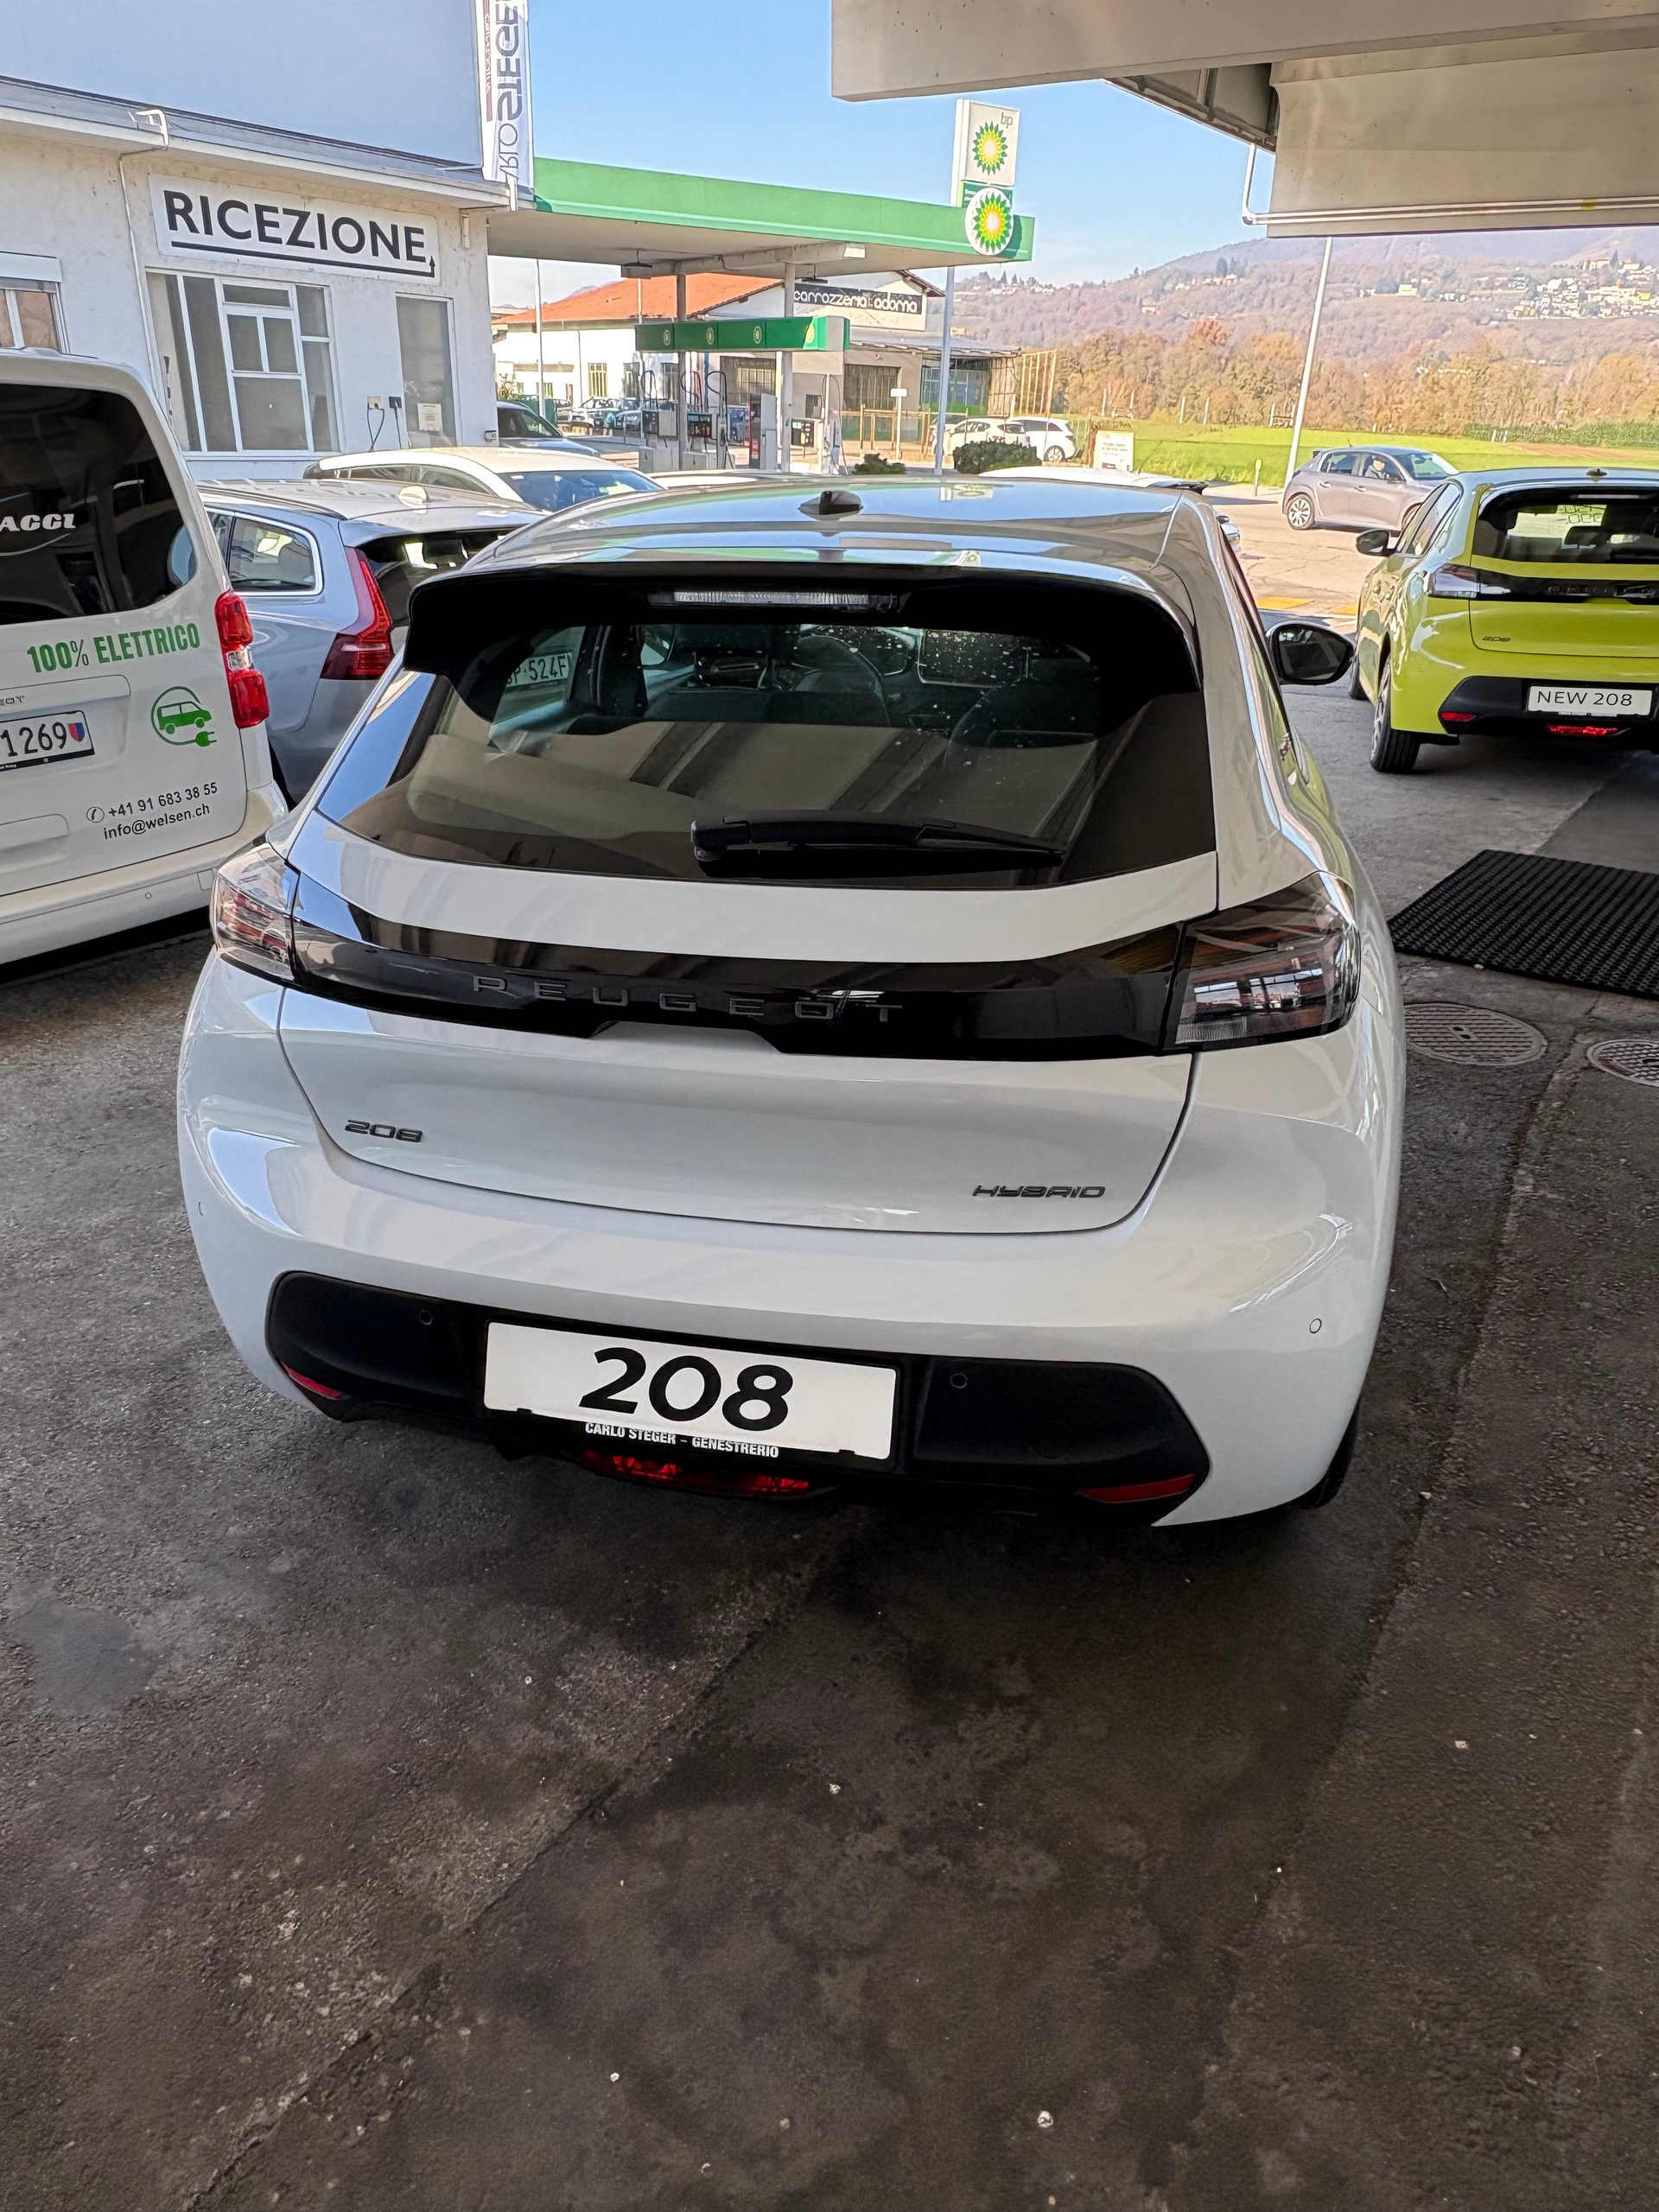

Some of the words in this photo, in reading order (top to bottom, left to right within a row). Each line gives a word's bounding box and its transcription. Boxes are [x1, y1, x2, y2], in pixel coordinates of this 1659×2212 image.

[1000, 111, 1014, 129] bp
[163, 189, 427, 264] RICEZIONE
[793, 289, 867, 308] carrozzeria
[0, 513, 76, 532] ACCI
[27, 639, 89, 673] 100%
[92, 623, 200, 664] ELETTRICO
[1537, 690, 1588, 705] NEW
[1593, 692, 1632, 706] 208
[0, 721, 67, 757] 1269
[108, 801, 133, 817] +41
[137, 797, 154, 811] 91
[158, 791, 182, 807] 683
[184, 786, 200, 800] 38
[203, 781, 218, 796] 55
[103, 804, 210, 840] info@welsen.ch
[473, 974, 903, 1023] PEUGEOT
[345, 1119, 423, 1143] 208
[972, 1185, 1106, 1198] HYBRID
[578, 1346, 794, 1432] 208
[584, 1422, 626, 1438] CARLO
[628, 1428, 677, 1445] STEGER
[691, 1436, 779, 1459] GENESTRERIO
